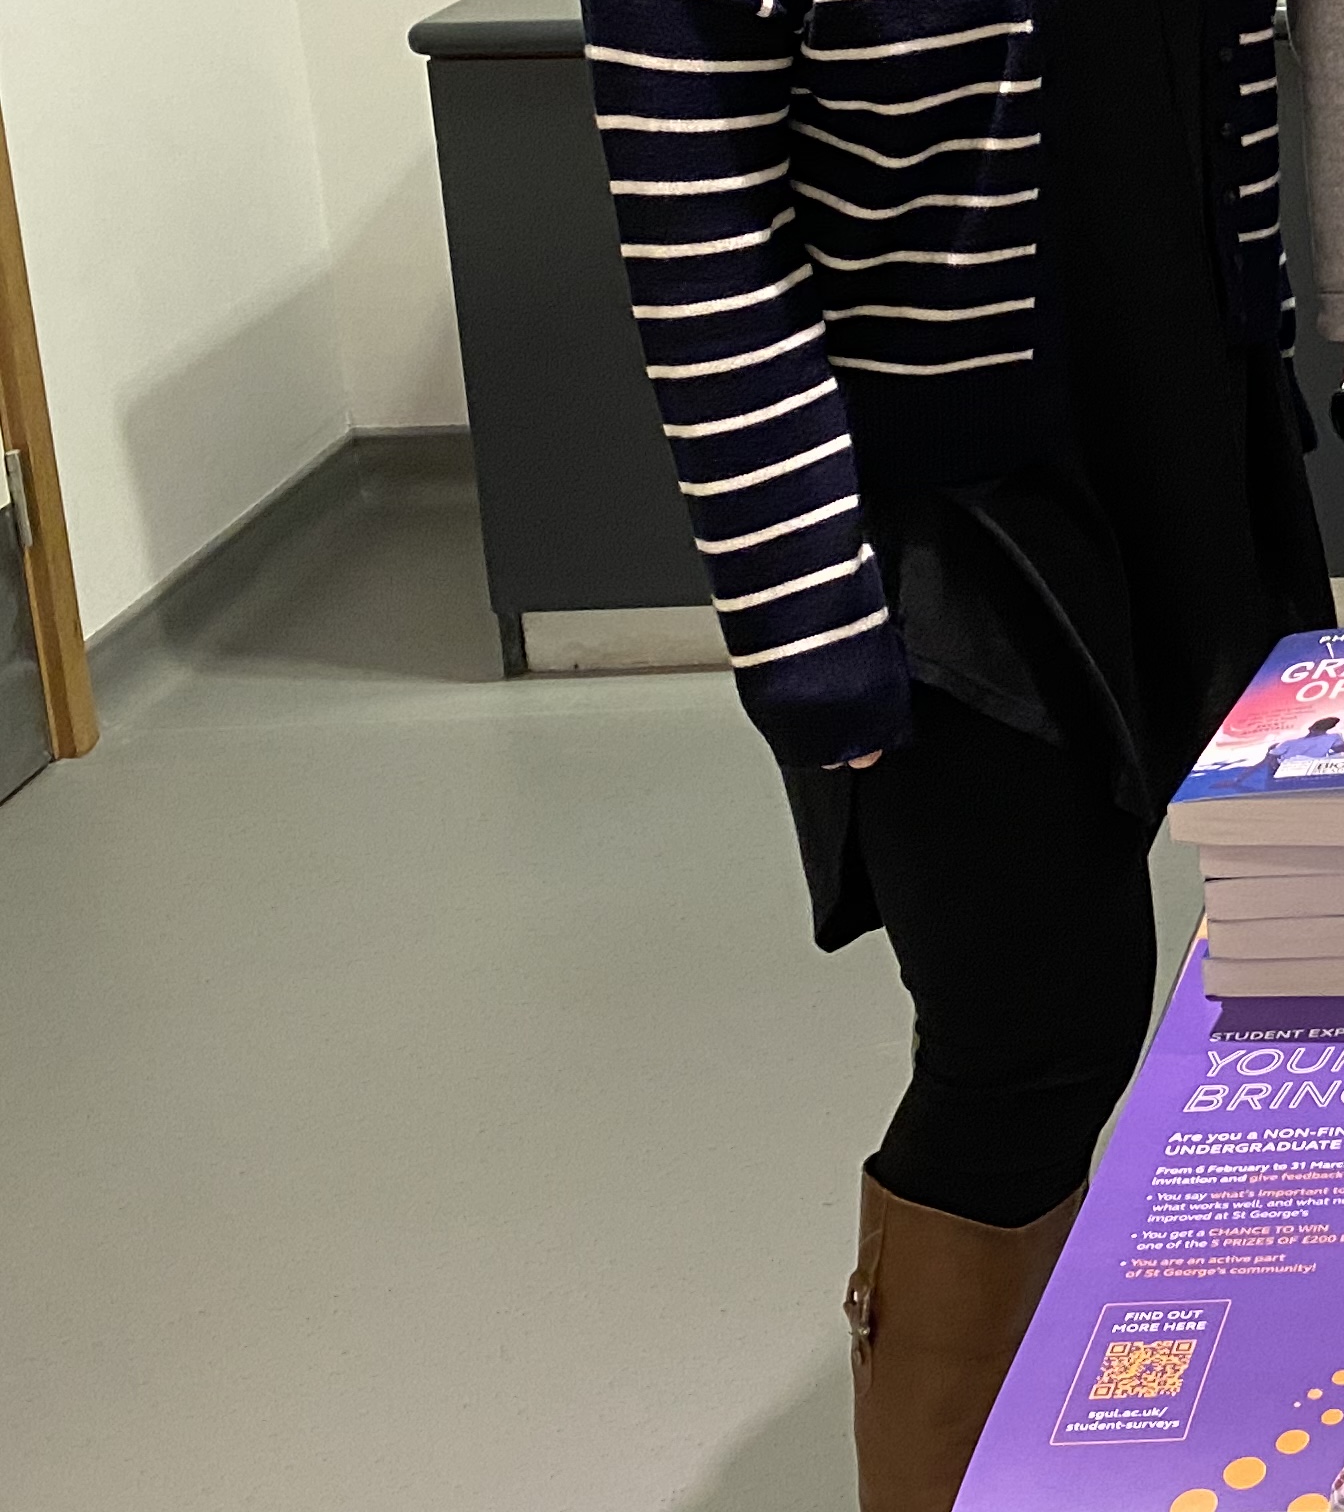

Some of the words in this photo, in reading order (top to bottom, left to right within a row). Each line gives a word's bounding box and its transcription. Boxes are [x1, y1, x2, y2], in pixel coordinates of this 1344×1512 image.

[1209, 1029, 1304, 1042] STUDENT
[1168, 1132, 1203, 1143] Are
[1205, 1132, 1243, 1144] you
[1246, 1131, 1258, 1140] a
[1164, 1139, 1342, 1156] UNDERGRADUATE
[1155, 1166, 1193, 1176] From
[1195, 1165, 1206, 1174] 6
[1207, 1163, 1270, 1174] February
[1273, 1162, 1288, 1171] to
[1290, 1161, 1306, 1170] 31
[1151, 1175, 1218, 1186] invitation
[1219, 1174, 1248, 1184] and
[1249, 1173, 1279, 1184] give
[1281, 1171, 1344, 1181] feedback
[1157, 1192, 1182, 1201] You
[1184, 1192, 1208, 1202] say
[1210, 1190, 1255, 1200] what's
[1258, 1187, 1329, 1198] important
[1152, 1203, 1186, 1212] what
[1189, 1201, 1229, 1211] works
[1232, 1199, 1263, 1210] well,
[1266, 1198, 1293, 1208] and
[1296, 1197, 1329, 1206] what
[1147, 1212, 1213, 1224] improved
[1214, 1212, 1228, 1220] at
[1231, 1210, 1246, 1219] St
[1249, 1208, 1309, 1221] George's
[1142, 1230, 1168, 1240] You
[1170, 1230, 1194, 1240] get
[1208, 1226, 1270, 1237] CHANCE
[1275, 1224, 1294, 1234] TO
[1298, 1224, 1329, 1234] WIN
[1136, 1242, 1164, 1251] one
[1166, 1240, 1182, 1250] of
[1184, 1239, 1208, 1249] the
[1222, 1236, 1274, 1247] PRIZES
[1278, 1236, 1297, 1245] OF
[1131, 1258, 1158, 1267] You
[1160, 1257, 1184, 1266] are
[1186, 1257, 1205, 1265] an
[1208, 1255, 1251, 1264] active
[1254, 1253, 1286, 1264] part
[1125, 1269, 1140, 1279] of
[1143, 1268, 1161, 1278] St
[1163, 1266, 1227, 1278] George's
[1229, 1262, 1317, 1276] community!
[1124, 1310, 1164, 1321] FIND
[1166, 1309, 1204, 1320] OUT
[1111, 1322, 1159, 1333] MORE
[1163, 1320, 1207, 1332] HERE
[1088, 1406, 1169, 1421] sgul.ac.uk/
[1065, 1420, 1180, 1432] student-surveys
